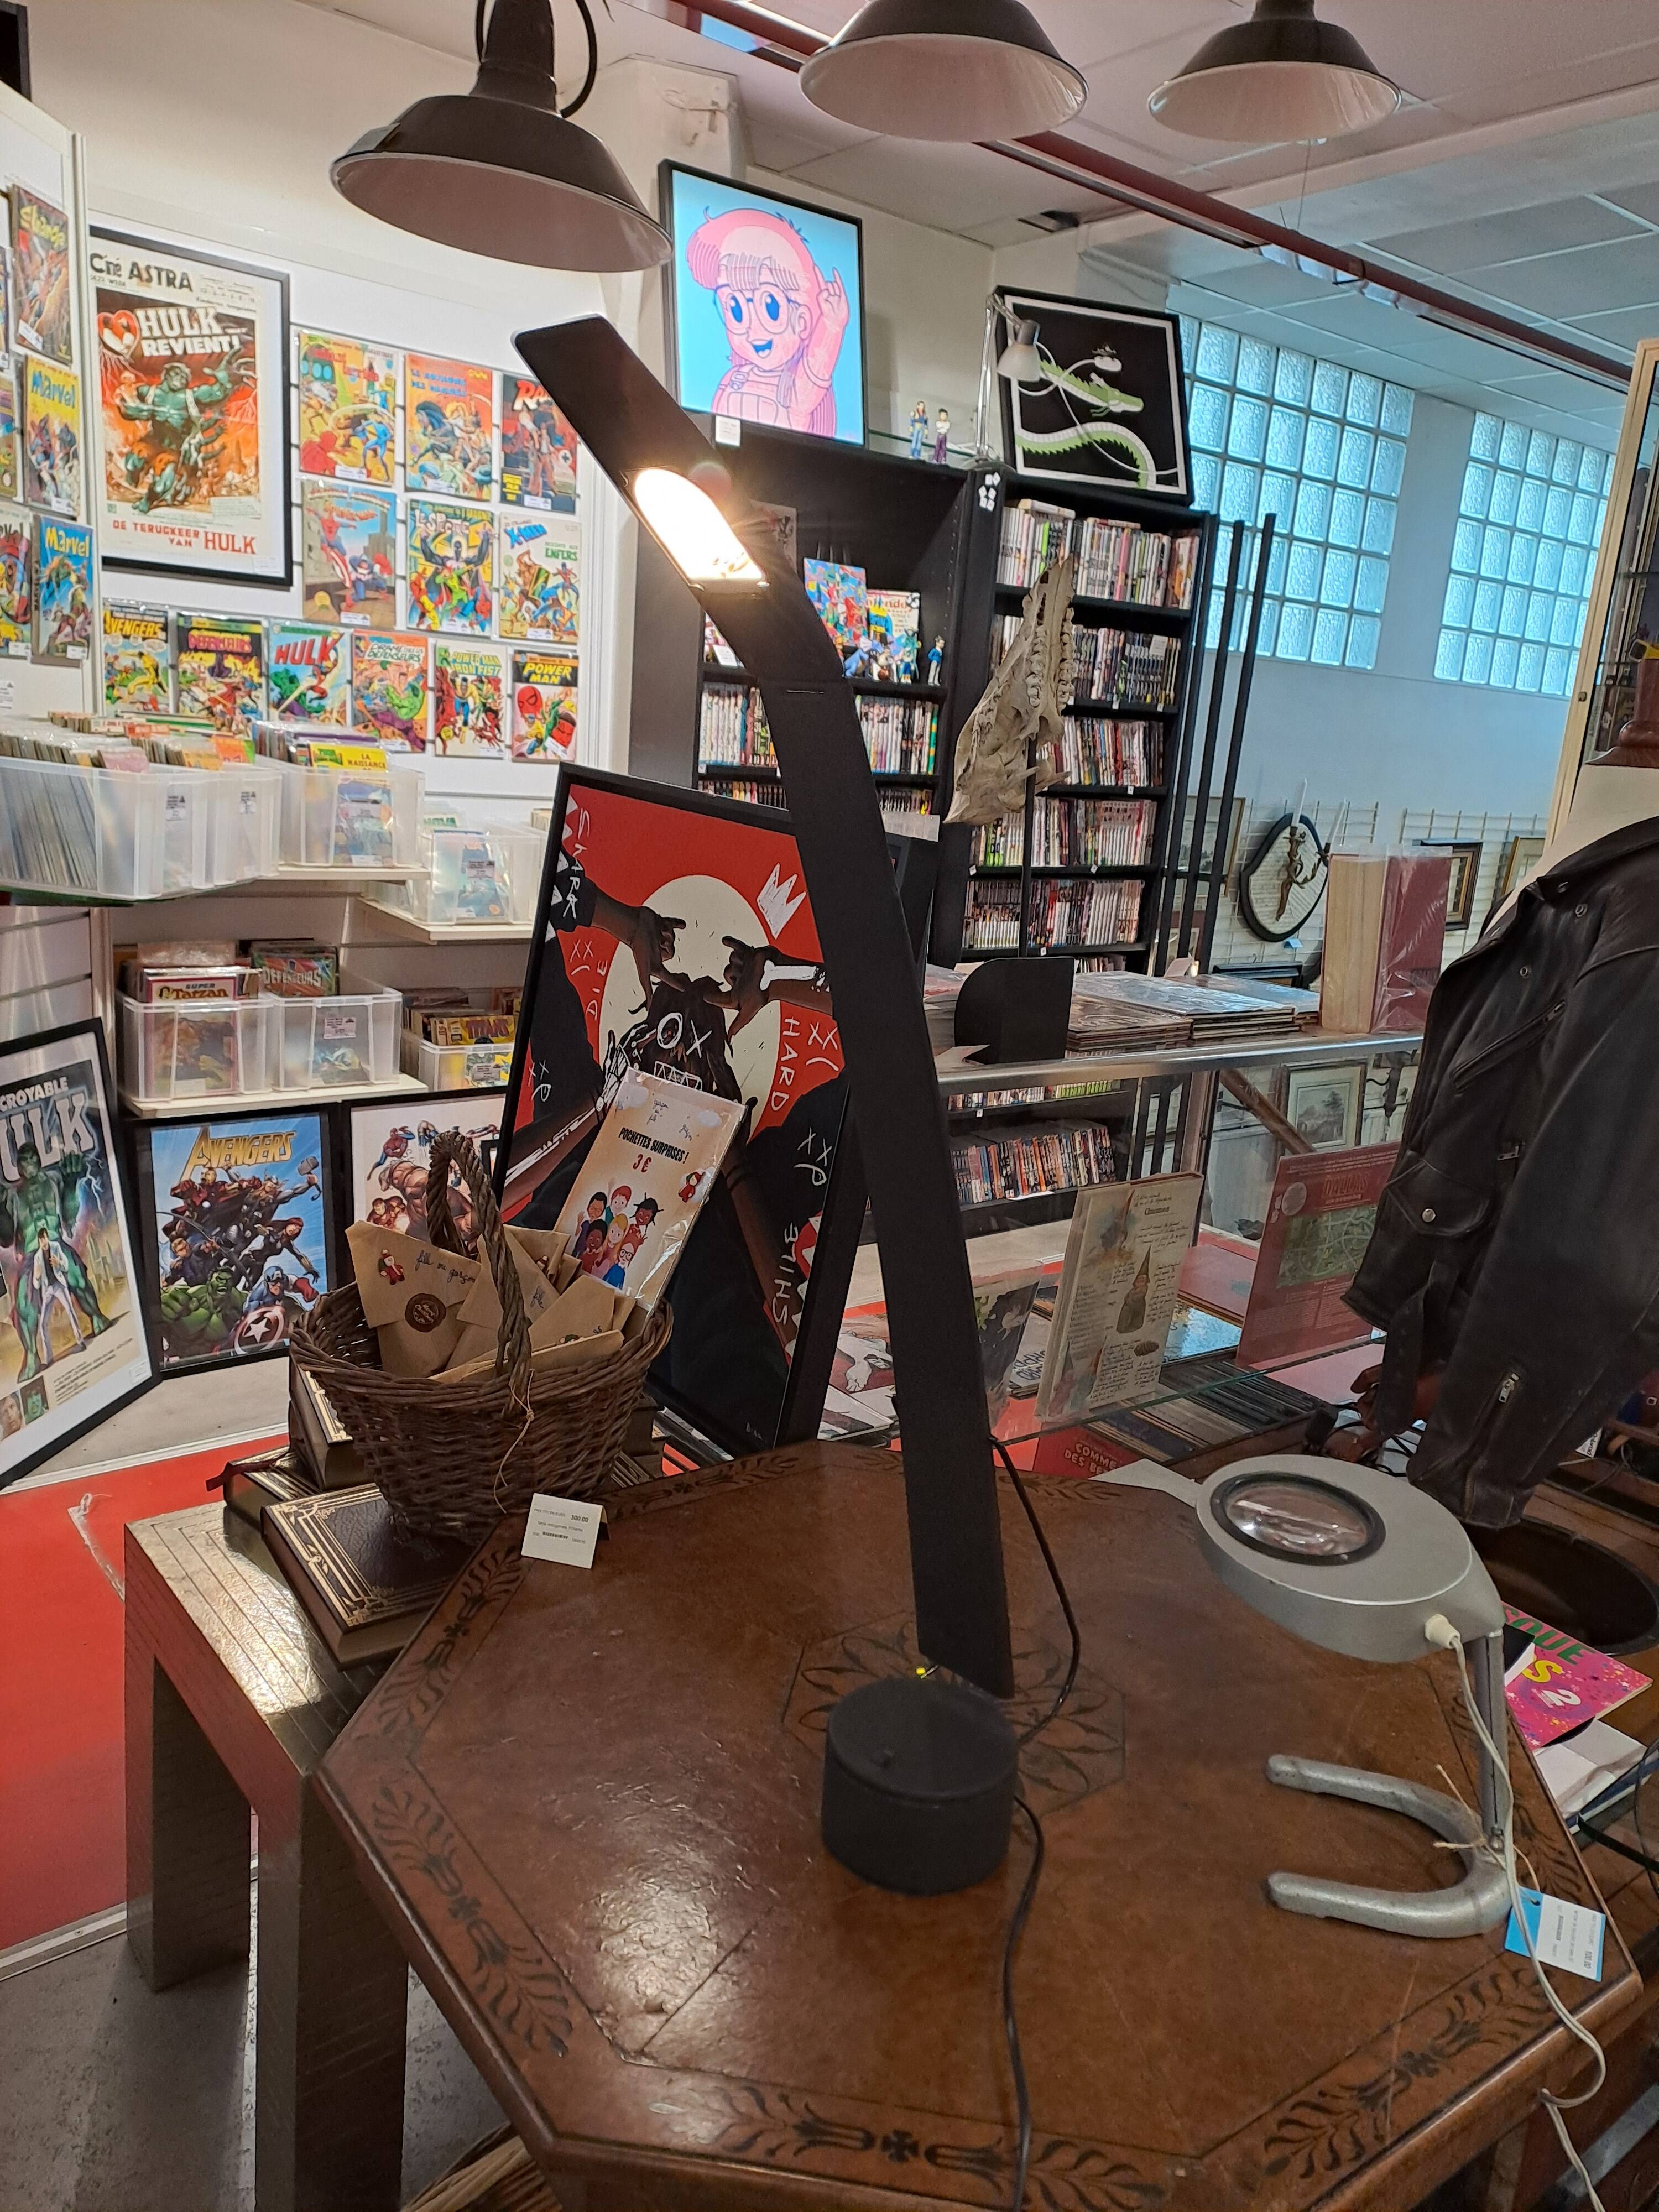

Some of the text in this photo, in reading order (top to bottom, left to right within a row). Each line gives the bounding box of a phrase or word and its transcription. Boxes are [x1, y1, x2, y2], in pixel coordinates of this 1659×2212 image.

[128, 260, 193, 292] ASTRA
[134, 306, 223, 338] HULK
[30, 371, 75, 409] Marvel
[113, 519, 127, 530] DE
[504, 524, 547, 549] X-MEN
[45, 526, 90, 557] Marvel
[168, 530, 257, 555] VAN HULK
[274, 633, 344, 665] HULK
[523, 662, 572, 680] POWER
[528, 673, 562, 685] MAN
[171, 987, 229, 1000] Tarzan
[771, 1016, 800, 1112] HARD
[179, 1125, 295, 1182] AVENGERS
[618, 1126, 652, 1149] POCHETTES
[650, 1139, 685, 1162] SURPRISES
[632, 1153, 652, 1173] 3 €
[1063, 1449, 1085, 1467] DES
[1074, 1442, 1117, 1470] COMME
